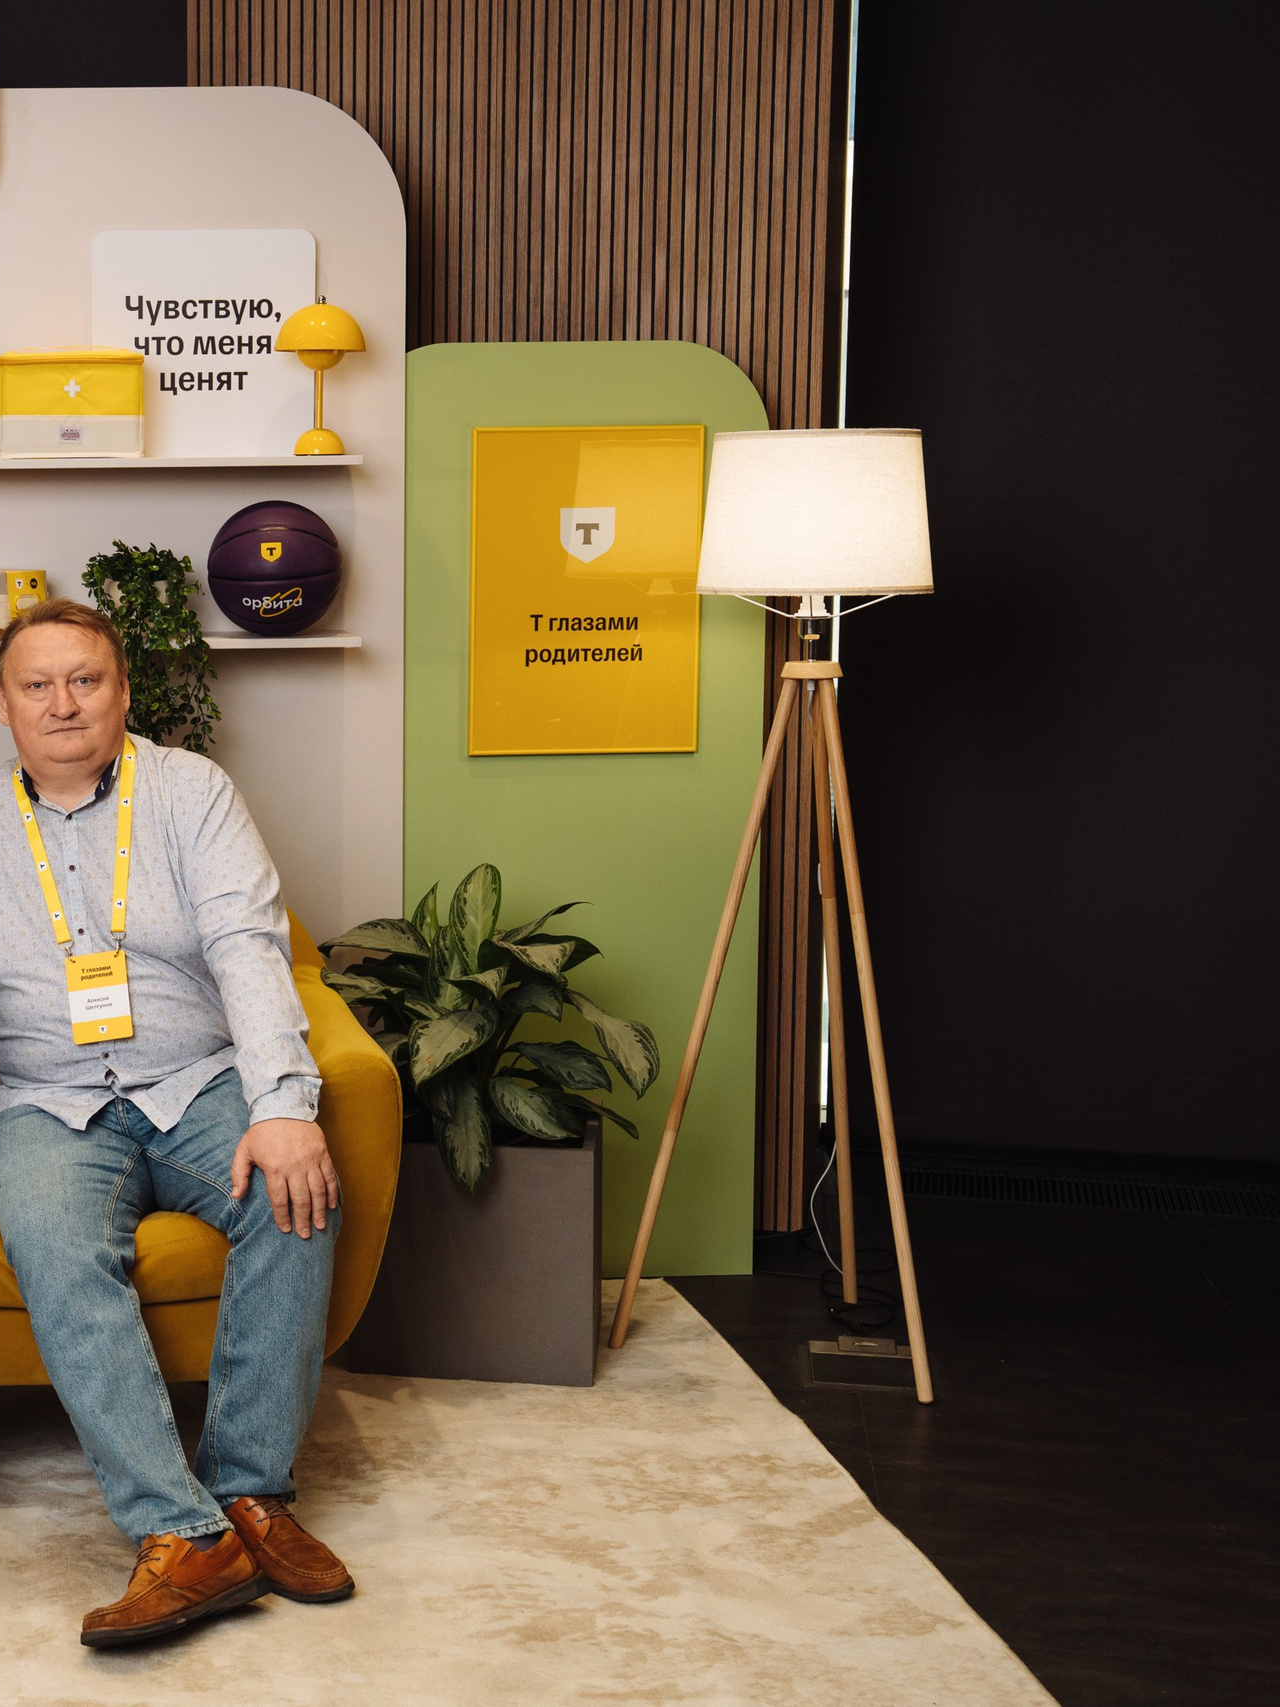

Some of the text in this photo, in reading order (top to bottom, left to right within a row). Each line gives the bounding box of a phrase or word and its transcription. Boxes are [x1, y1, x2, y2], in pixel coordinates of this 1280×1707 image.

[125, 295, 282, 326] Чувствую,
[134, 334, 272, 356] что меня
[159, 371, 248, 396] ценят
[575, 522, 600, 545] Т
[242, 594, 303, 613] орбита
[529, 614, 639, 632] Т глазами
[524, 643, 643, 667] родителей
[80, 971, 113, 981] родителей
[86, 965, 111, 973] глазами
